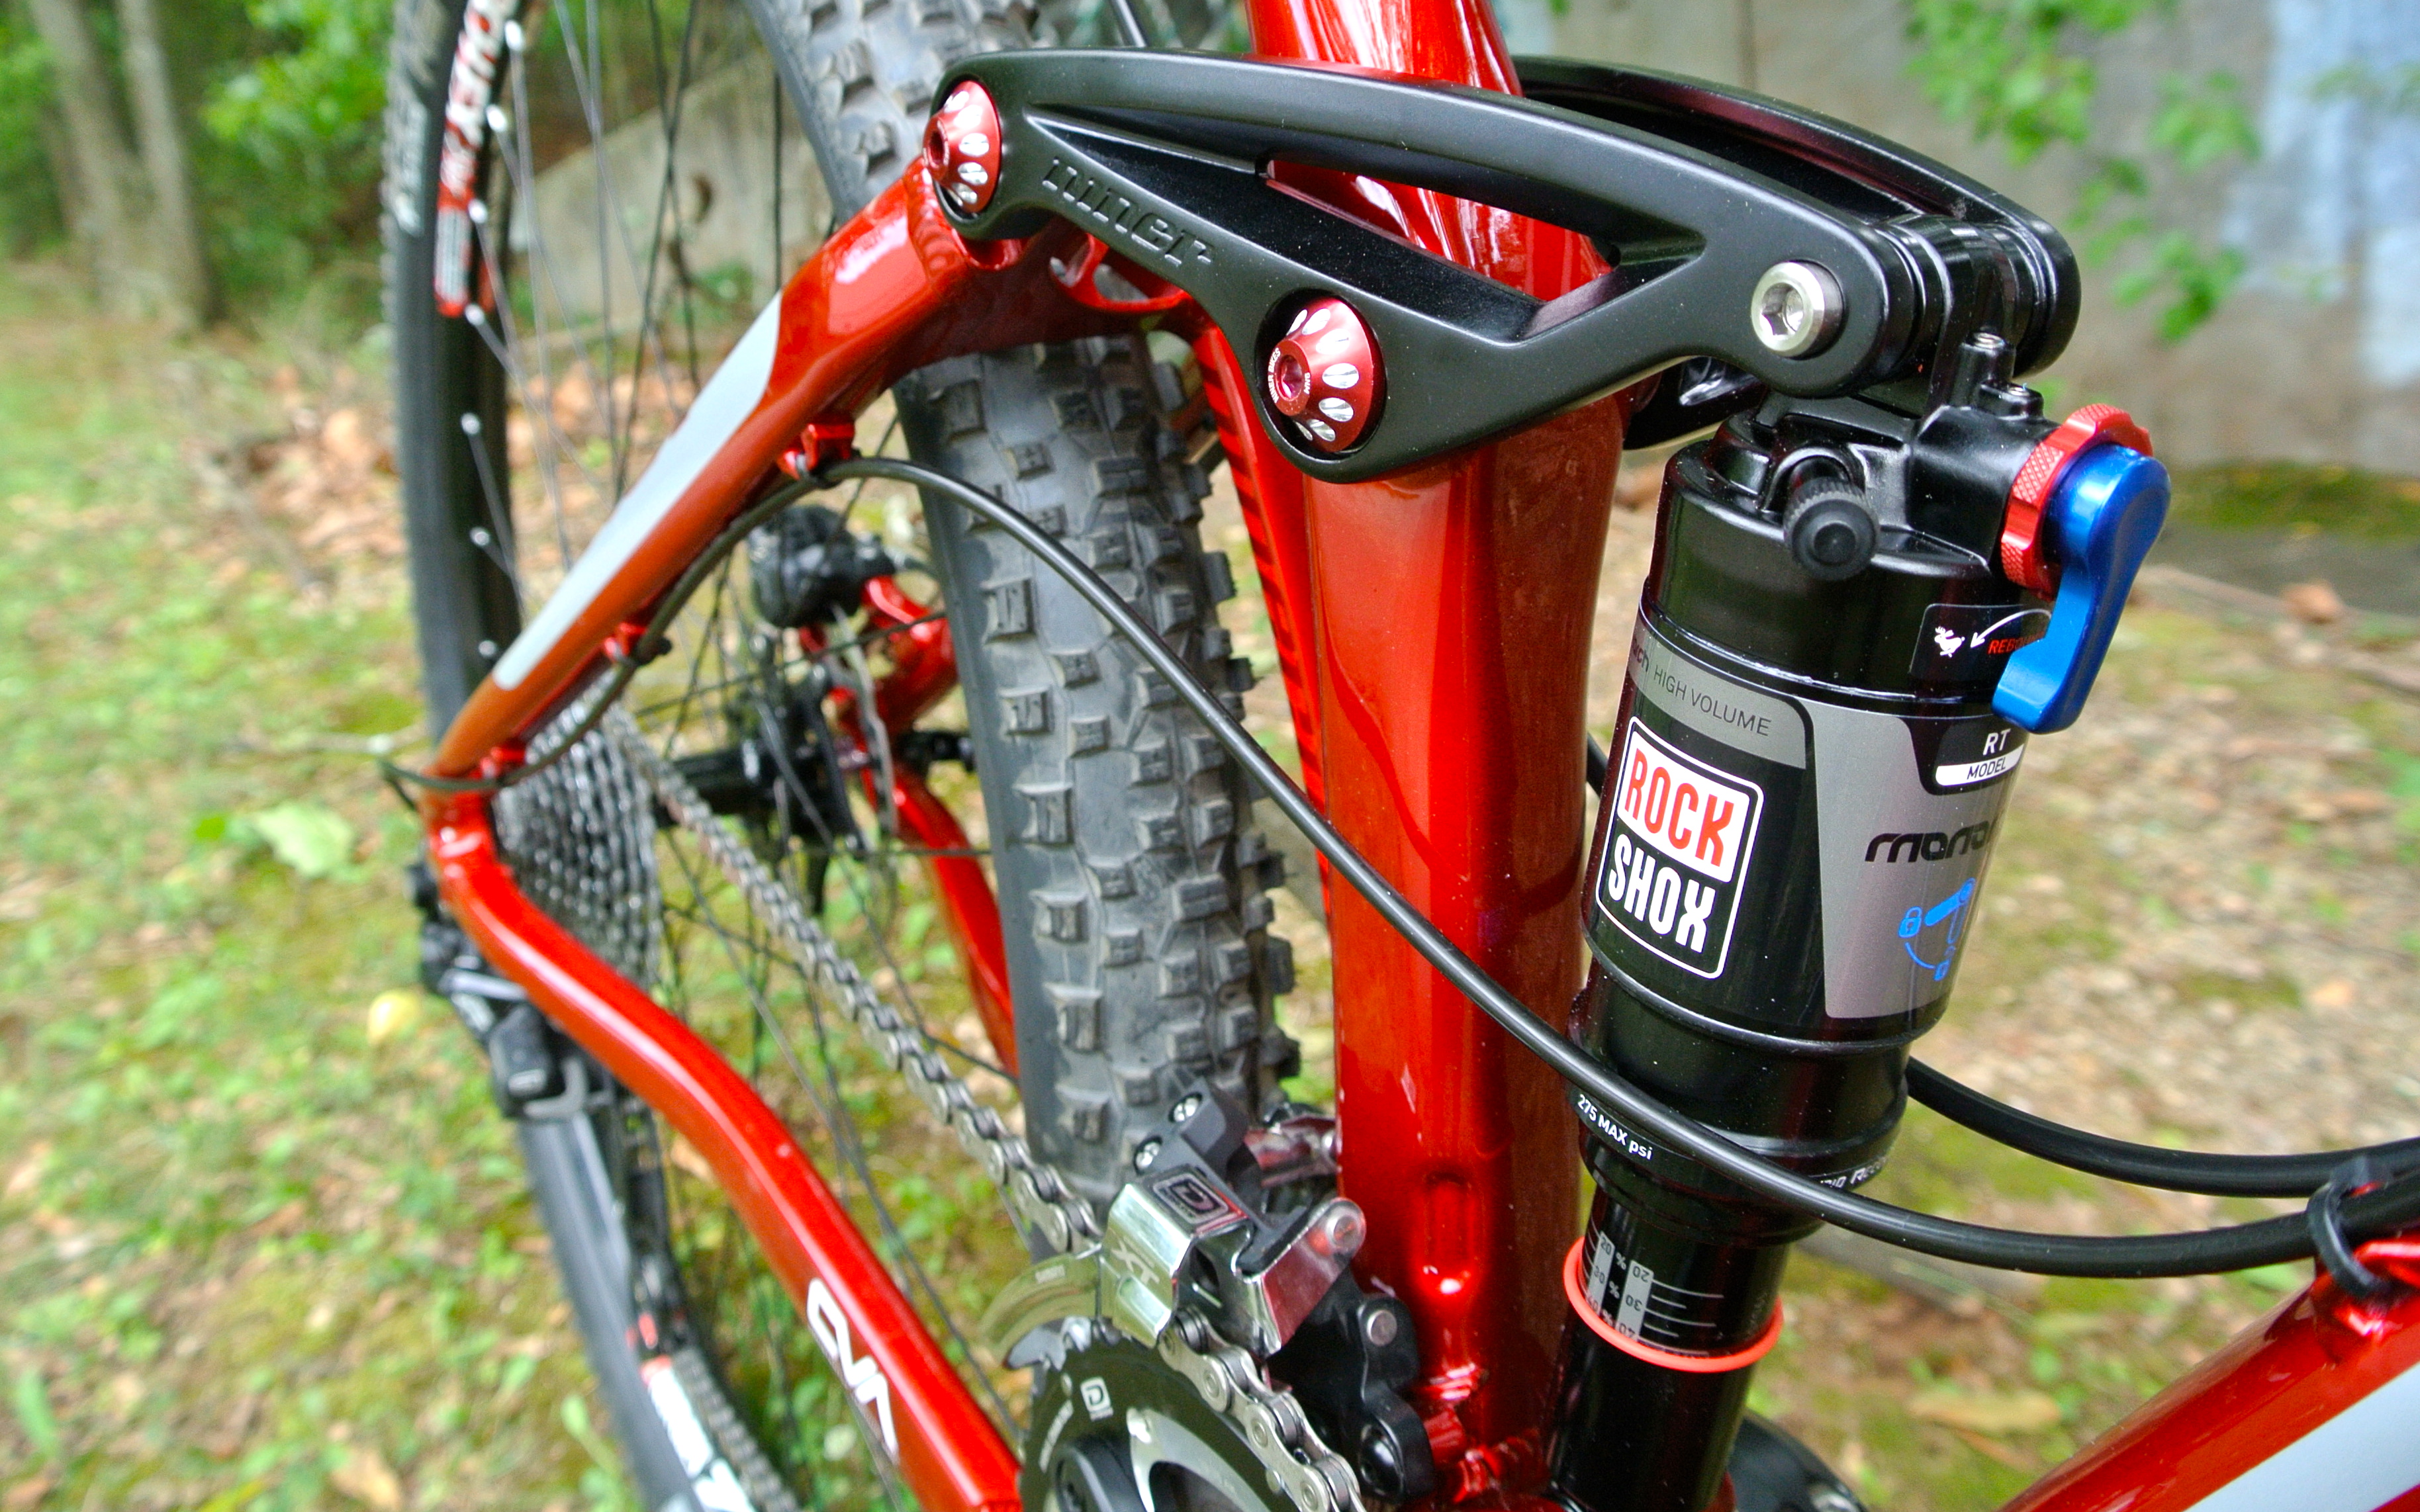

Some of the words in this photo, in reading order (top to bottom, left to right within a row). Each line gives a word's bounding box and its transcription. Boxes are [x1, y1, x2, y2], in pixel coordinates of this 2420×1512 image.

[1268, 347, 1281, 373] BIKES
[1653, 664, 1687, 701] HIGH
[1691, 688, 1772, 737] VOLUME
[1982, 728, 2012, 756] RT
[1967, 756, 2006, 780] MODEL
[1624, 748, 1735, 867] ROCK
[1608, 833, 1716, 954] SHOX
[1577, 1094, 1598, 1122] 275
[1598, 1114, 1628, 1146] MAX
[1629, 1139, 1653, 1161] psi
[1601, 1236, 1612, 1255] 20
[1111, 1240, 1160, 1284] XT
[1633, 1265, 1650, 1282] 20
[1626, 1294, 1642, 1312] 30
